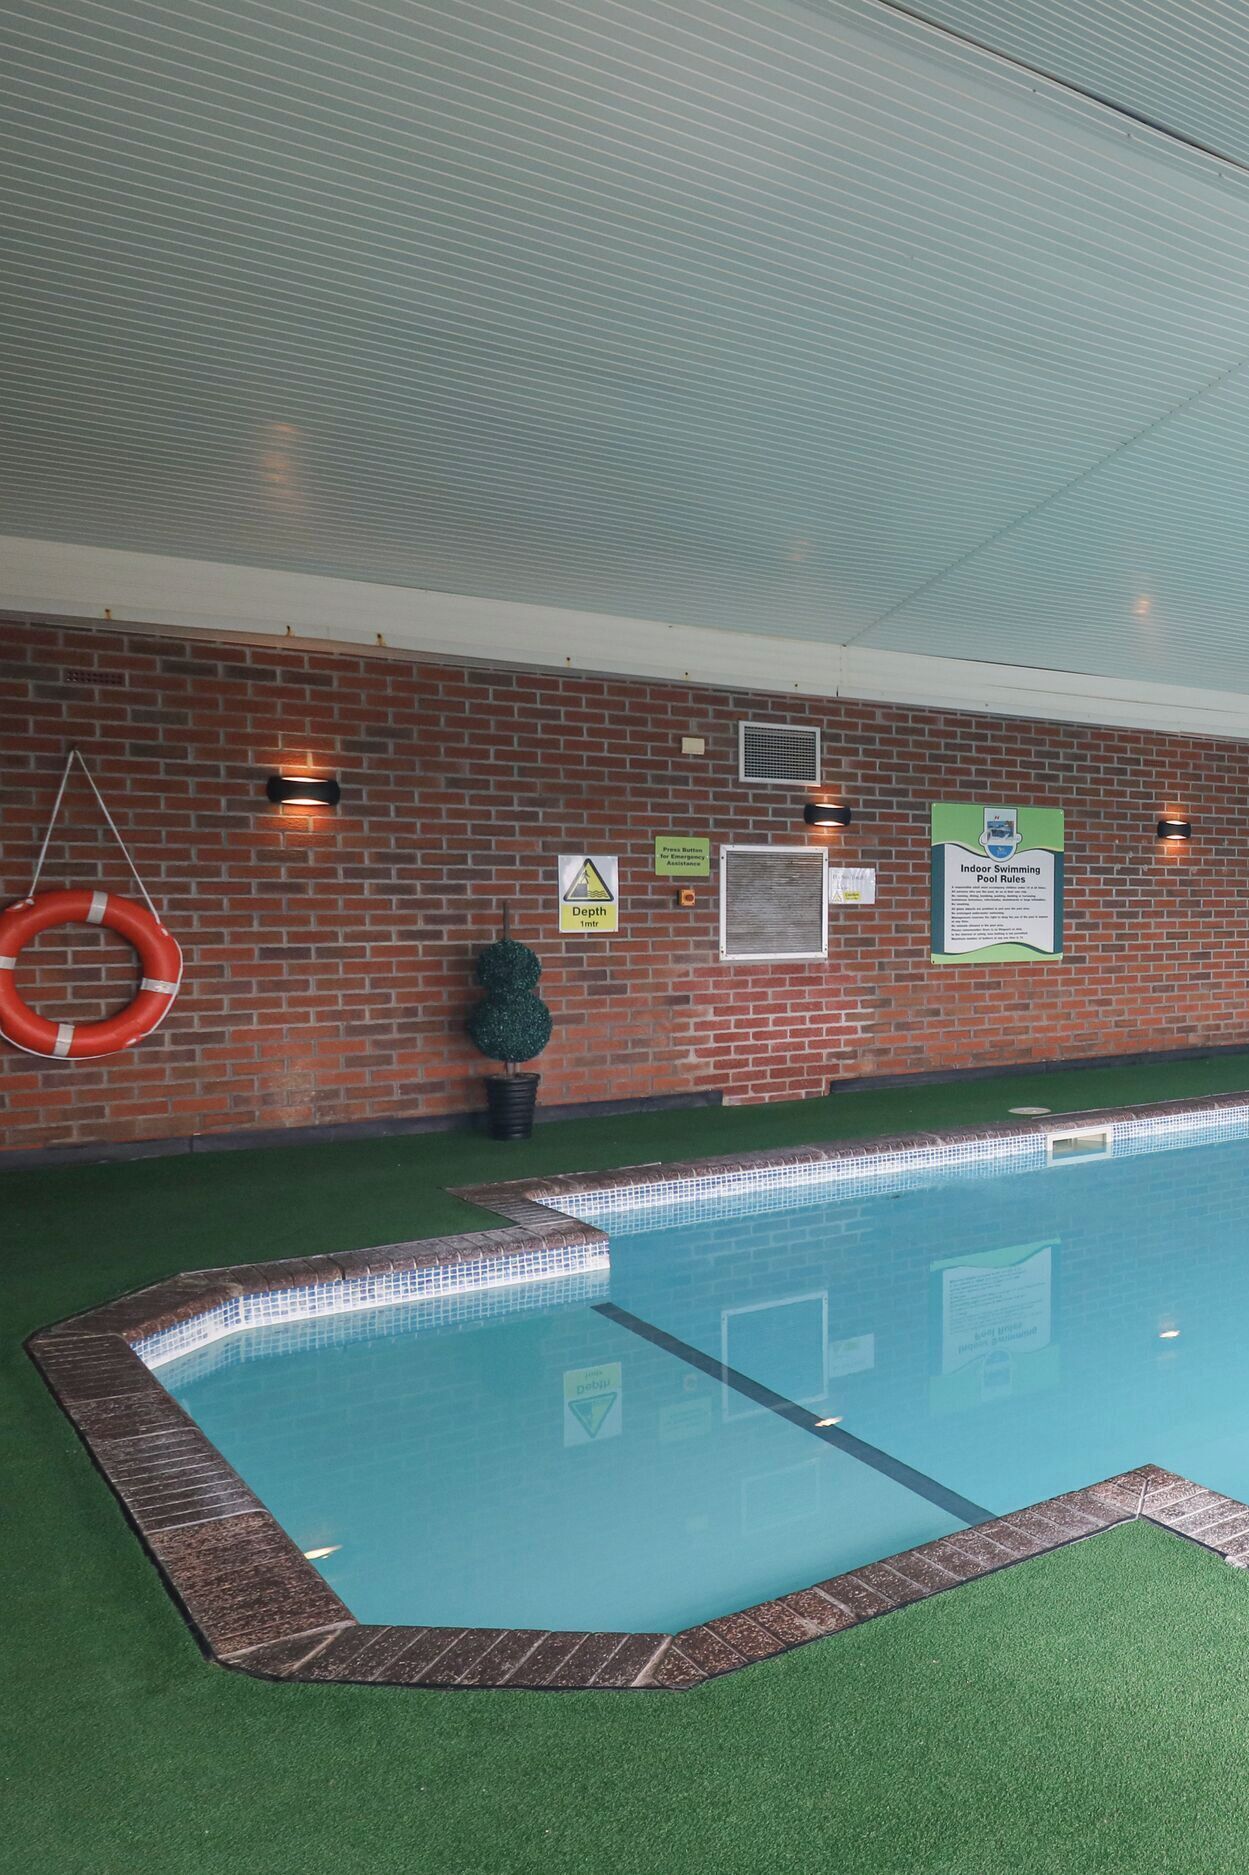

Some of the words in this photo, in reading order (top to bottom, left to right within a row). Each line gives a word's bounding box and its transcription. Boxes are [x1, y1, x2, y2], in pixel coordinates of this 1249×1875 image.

[961, 864, 992, 873] Indoor
[994, 865, 1041, 875] Swimming
[977, 874, 998, 883] Pool
[1000, 874, 1026, 883] Rules
[572, 906, 607, 918] Depth
[580, 920, 599, 928] 1mtr
